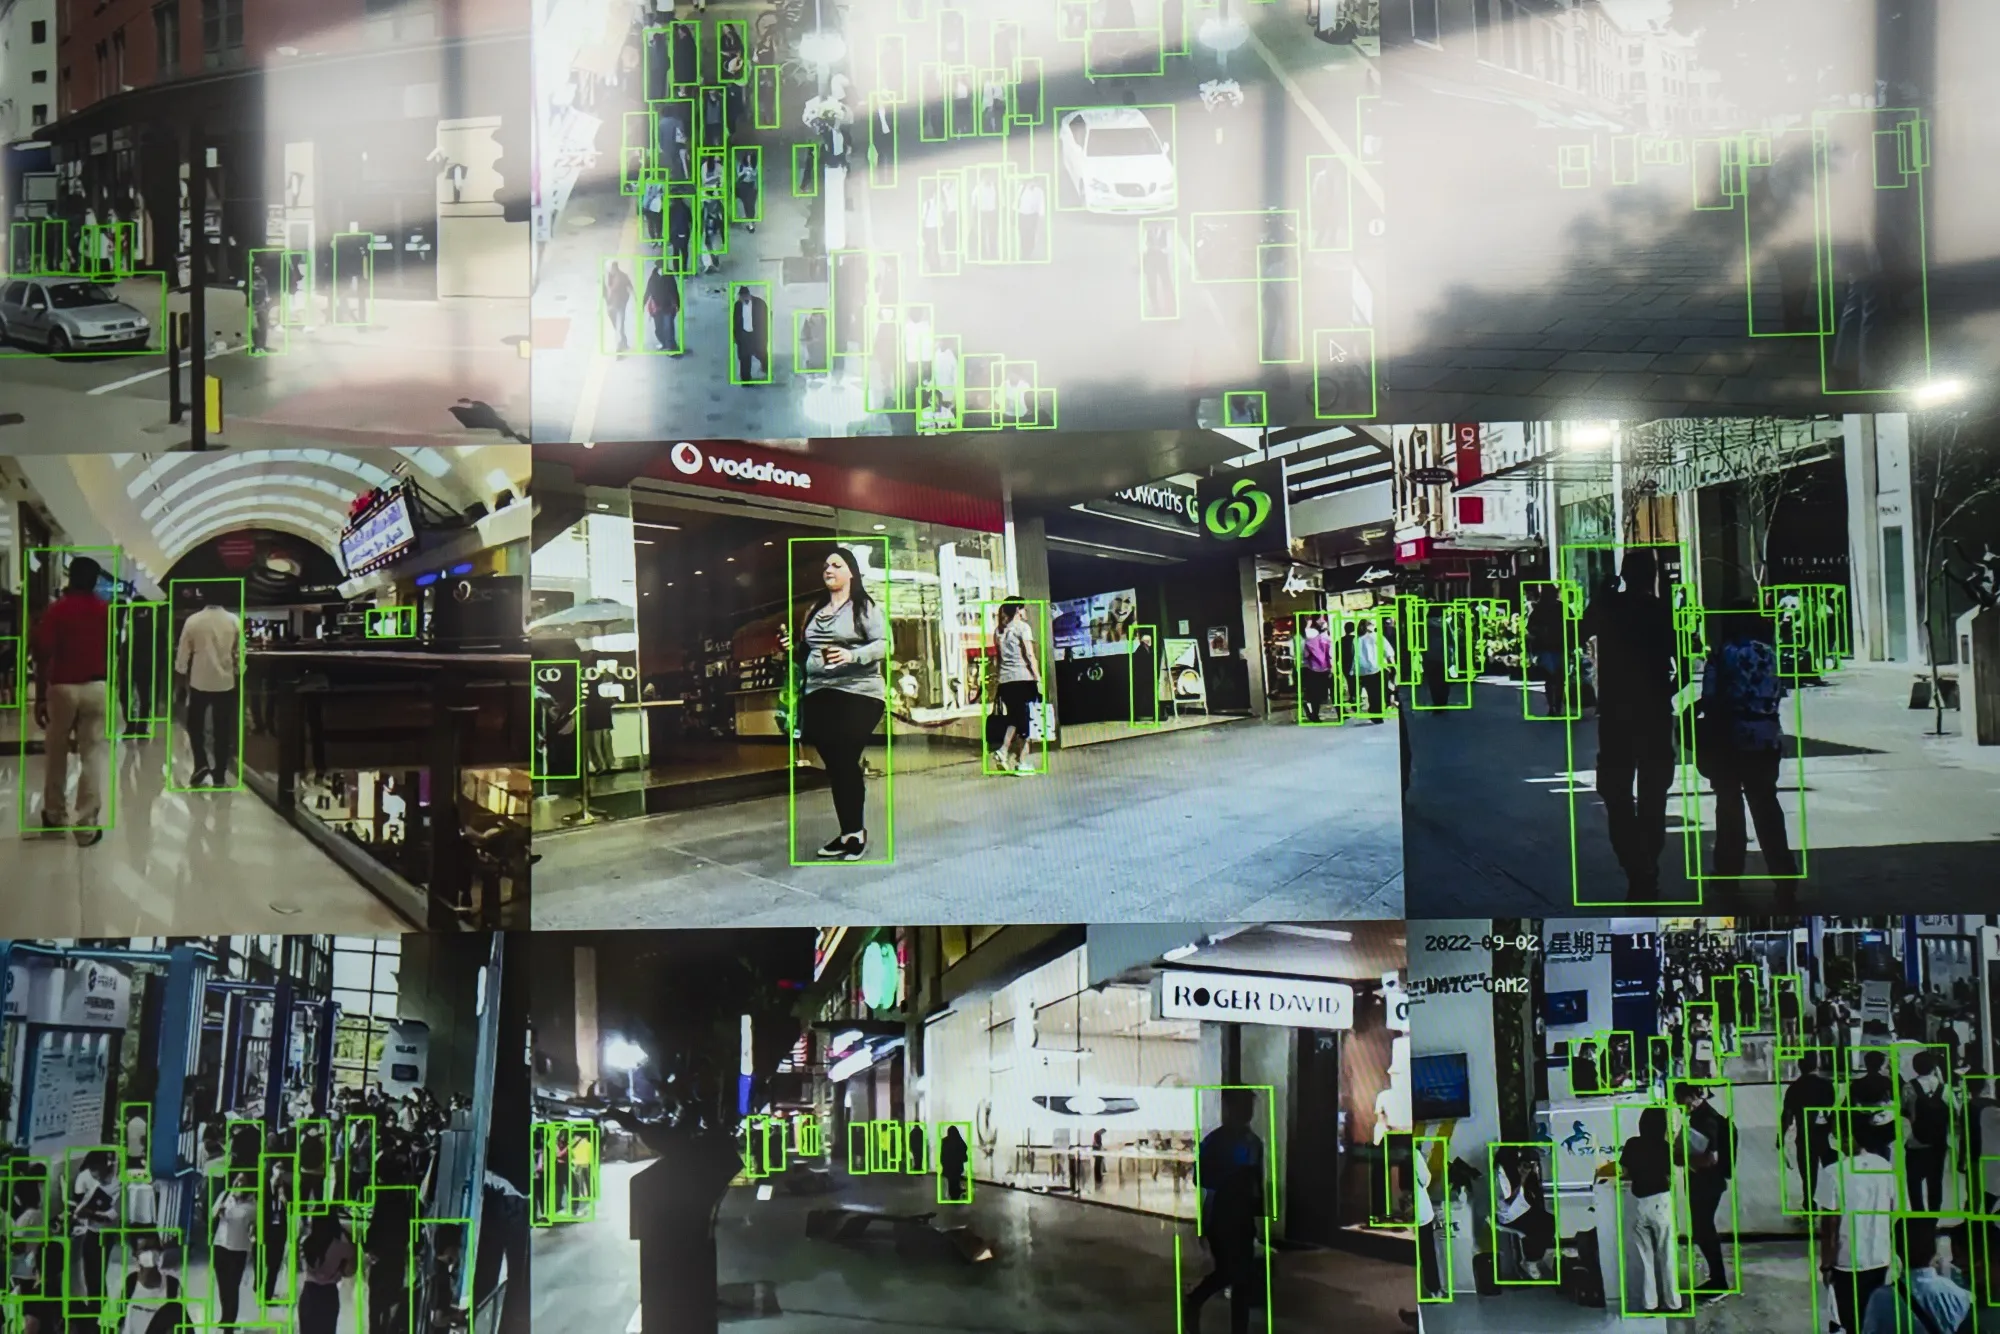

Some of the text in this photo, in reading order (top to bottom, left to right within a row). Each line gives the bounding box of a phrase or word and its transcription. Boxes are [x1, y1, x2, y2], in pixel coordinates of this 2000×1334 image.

[707, 454, 812, 490] vodafone
[1486, 567, 1510, 579] ZU
[1425, 934, 1540, 952] 2022-09-02
[1549, 931, 1613, 955] 星期五
[1174, 984, 1341, 1016] ROGER DAVID
